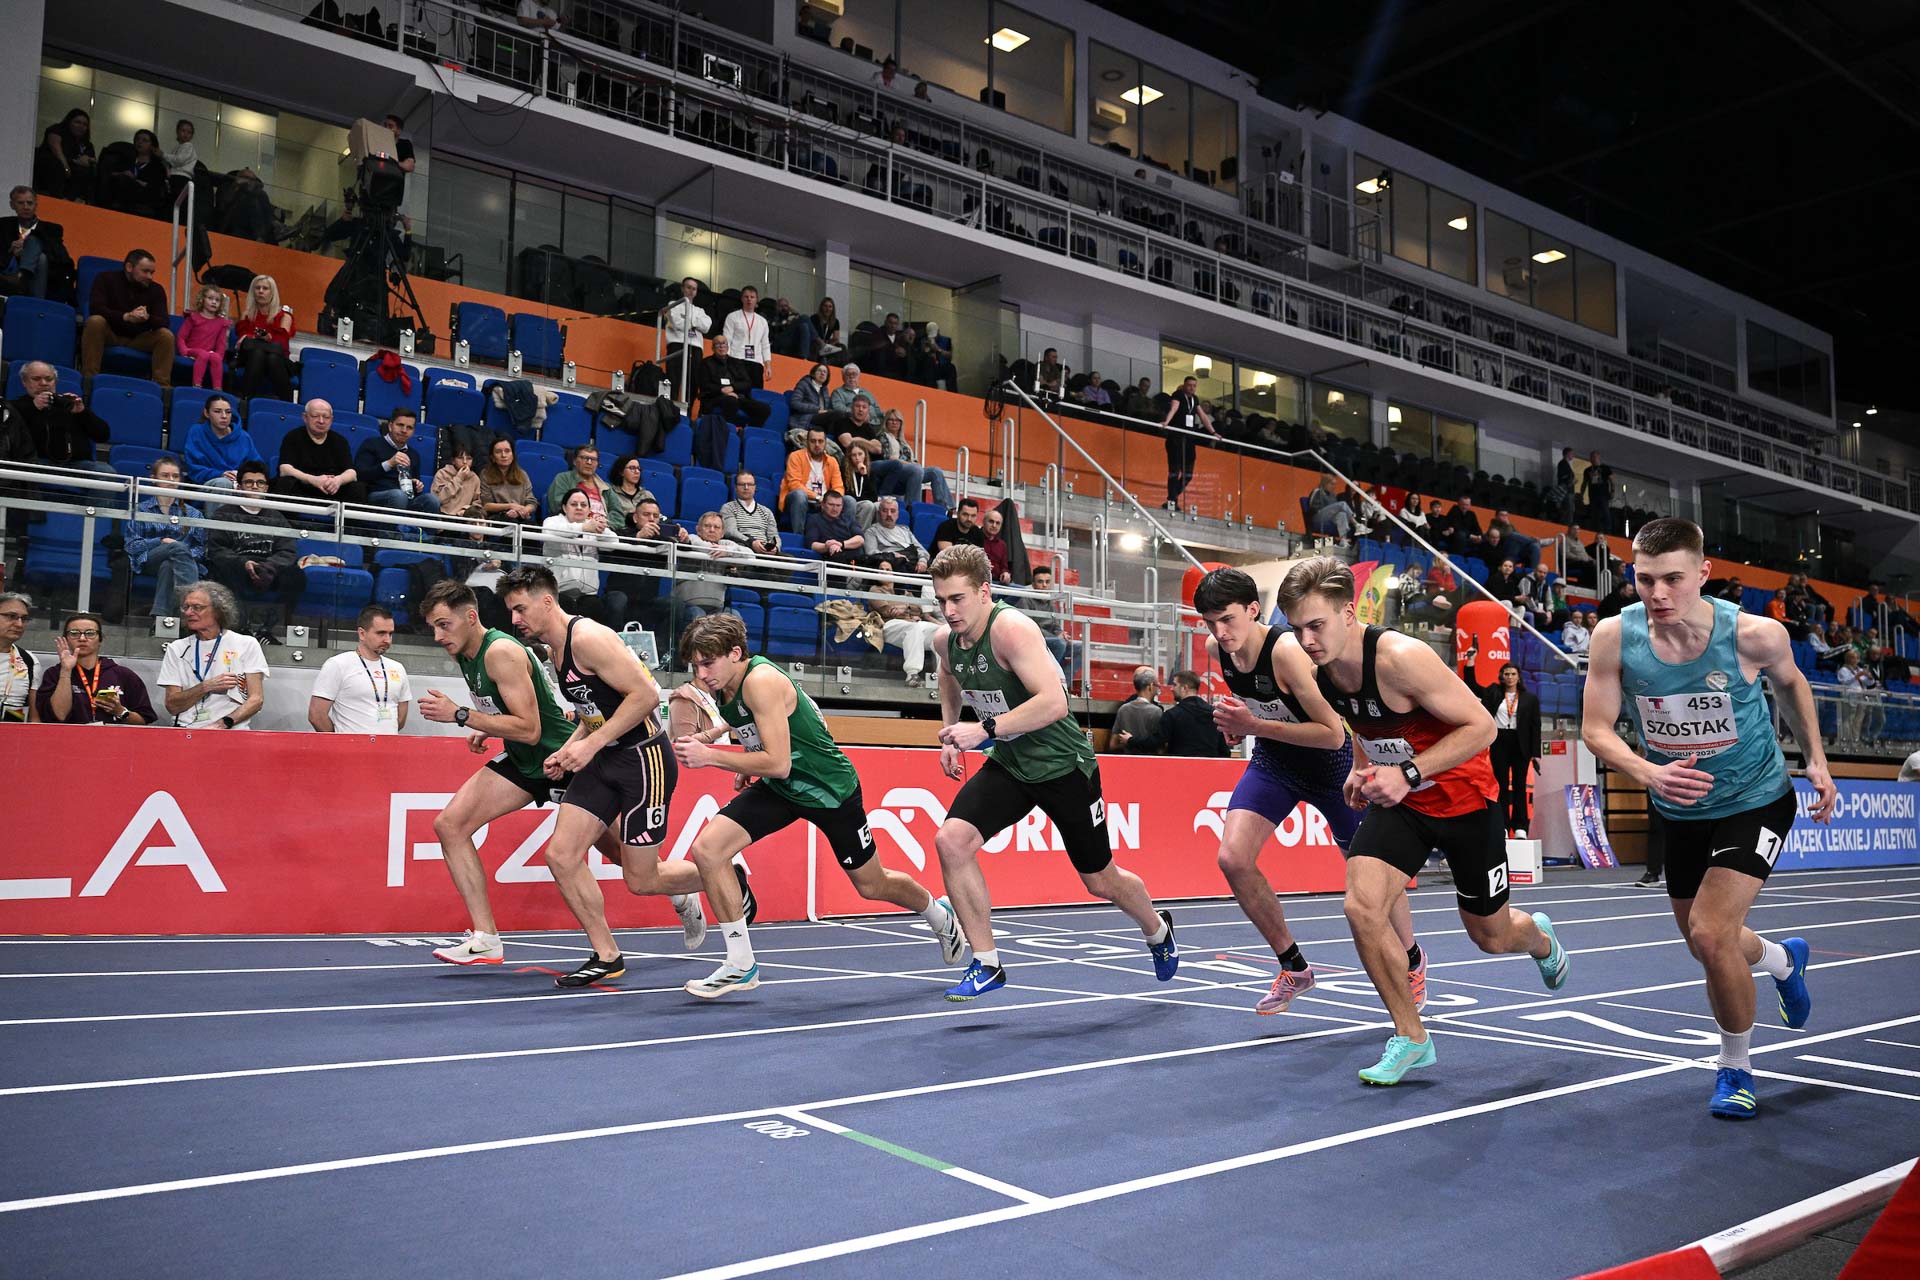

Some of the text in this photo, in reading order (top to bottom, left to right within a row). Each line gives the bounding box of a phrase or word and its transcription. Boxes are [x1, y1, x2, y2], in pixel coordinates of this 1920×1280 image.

[982, 693, 1000, 703] 176
[1687, 696, 1723, 711] 453
[1646, 718, 1731, 737] SZOSTAK
[1374, 742, 1400, 753] 241
[1095, 801, 1104, 819] 4
[1794, 791, 1915, 819] AWO-POMORSKI
[651, 808, 662, 826] 6
[864, 824, 871, 843] 5
[1826, 829, 1870, 852] LEKKIEJ
[1873, 828, 1917, 850] ATLETYKI
[1766, 837, 1777, 860] 1
[1494, 867, 1504, 893] 2
[743, 1120, 811, 1139] 800
